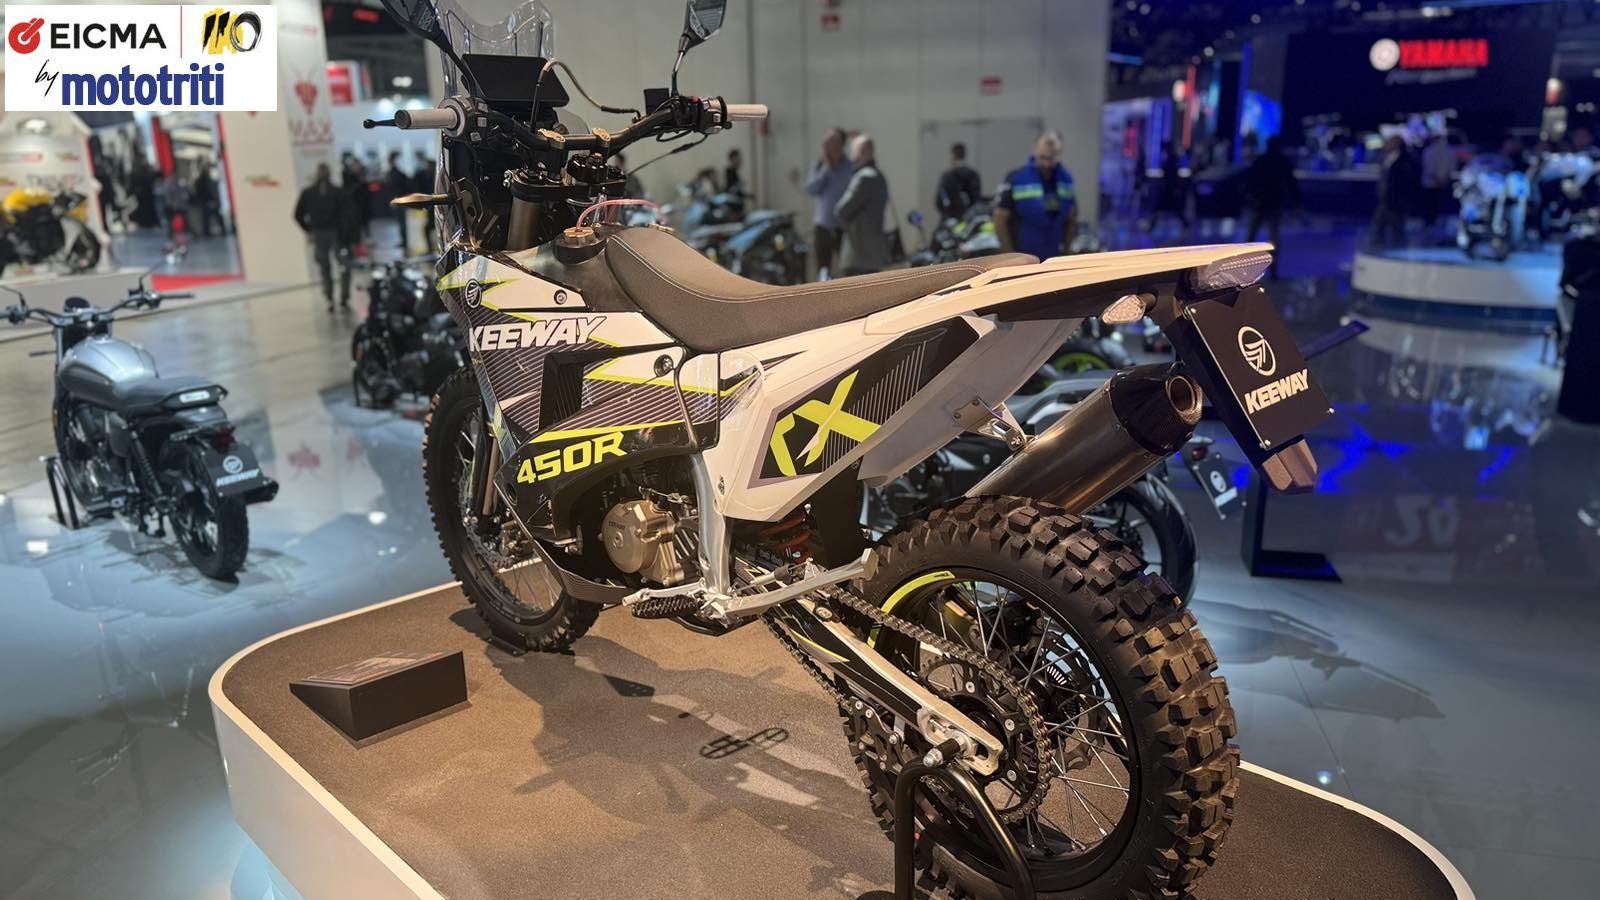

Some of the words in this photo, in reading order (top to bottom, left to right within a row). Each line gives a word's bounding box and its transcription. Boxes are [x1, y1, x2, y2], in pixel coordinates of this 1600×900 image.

[1400, 39, 1489, 68] YAMAHA
[468, 315, 607, 353] KEEWAY
[1244, 368, 1310, 414] KEEWAY
[517, 431, 628, 485] 450R
[216, 468, 261, 487] KEEWAY
